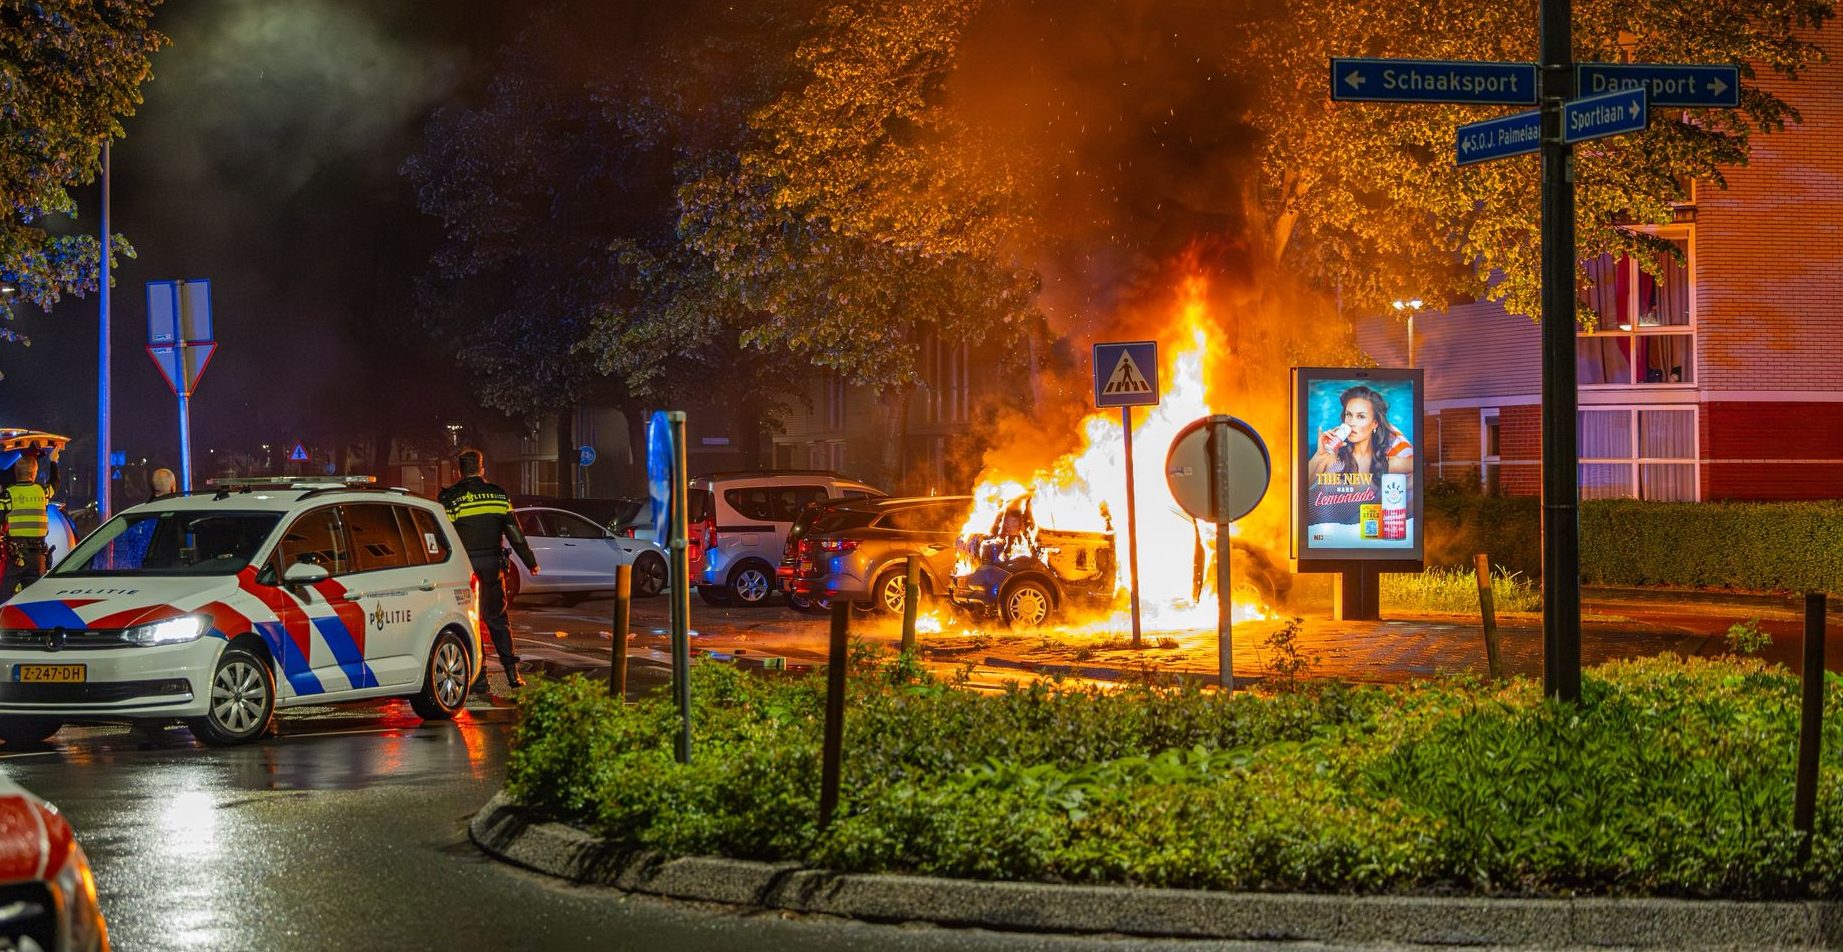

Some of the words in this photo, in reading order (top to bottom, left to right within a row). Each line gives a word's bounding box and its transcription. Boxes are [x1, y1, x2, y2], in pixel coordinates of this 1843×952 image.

[1383, 69, 1519, 94] Schaaksport
[1592, 73, 1696, 97] Damsport
[1571, 105, 1623, 132] Sportlaan
[1471, 131, 1495, 151] S.O.J.
[1316, 472, 1341, 485] THE
[1344, 472, 1374, 485] NEW
[462, 493, 494, 502] POLITIE
[1315, 487, 1375, 507] Lemonade
[56, 588, 140, 597] POLITIE
[370, 610, 411, 631] POLITIE
[24, 667, 80, 681] Z-247-DH
